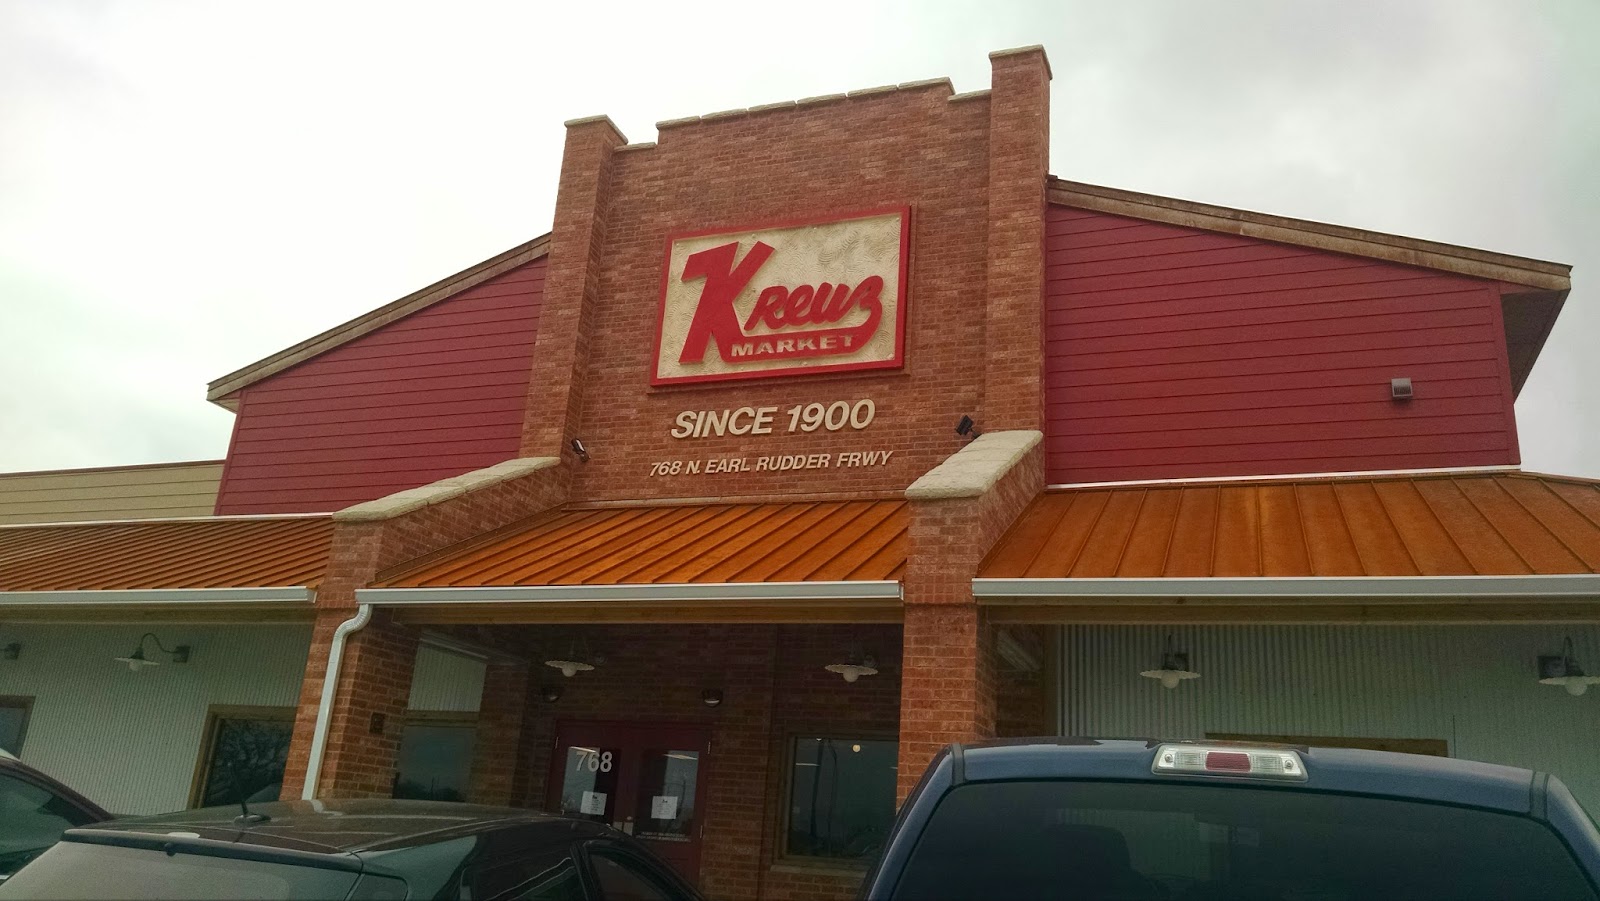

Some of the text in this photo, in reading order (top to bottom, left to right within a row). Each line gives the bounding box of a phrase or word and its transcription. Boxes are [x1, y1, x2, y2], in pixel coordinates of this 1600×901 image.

[731, 334, 855, 357] MARKET
[670, 399, 876, 439] SINCE 1900
[650, 461, 682, 477] 768
[705, 458, 750, 474] EARL
[756, 453, 831, 472] RUDDER
[837, 450, 893, 468] FRWY
[576, 751, 612, 772] 768
